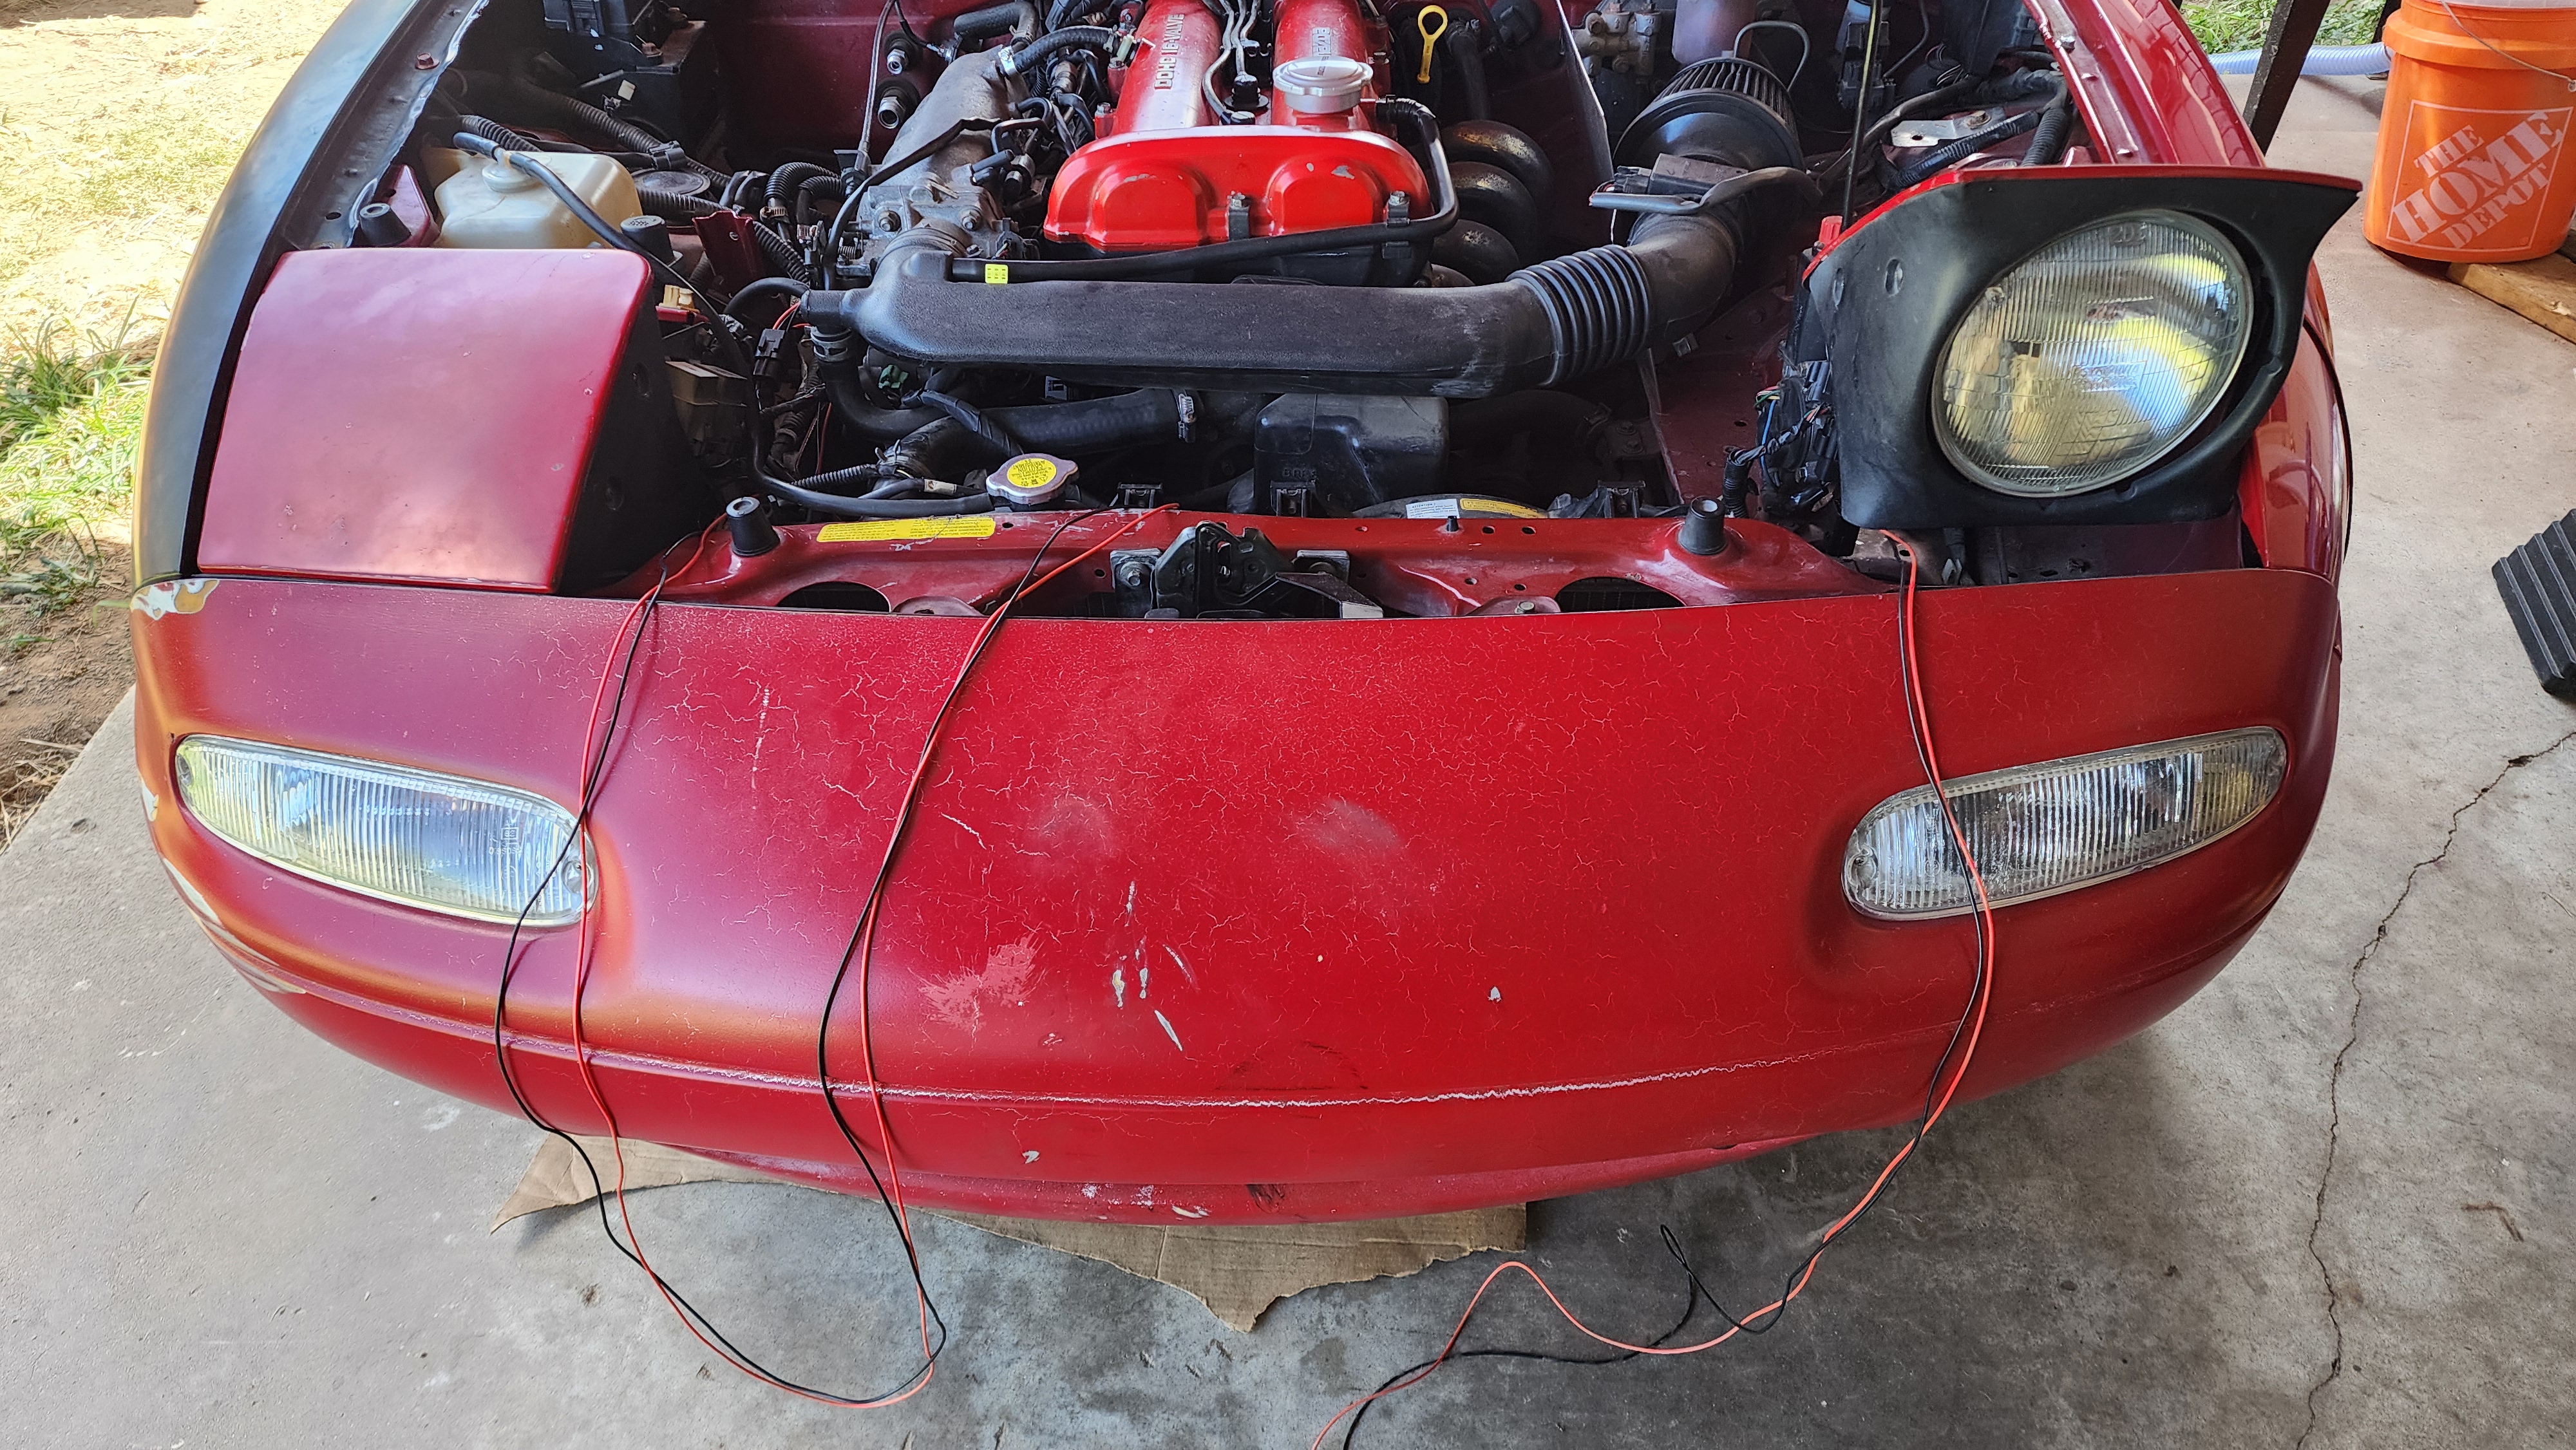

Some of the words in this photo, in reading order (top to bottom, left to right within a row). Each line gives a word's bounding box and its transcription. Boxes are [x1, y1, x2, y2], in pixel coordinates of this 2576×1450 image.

[1154, 57, 1177, 90] DOHC
[2392, 112, 2563, 243] HOME
[2414, 125, 2484, 178] THE
[2441, 164, 2550, 249] DEPOT
